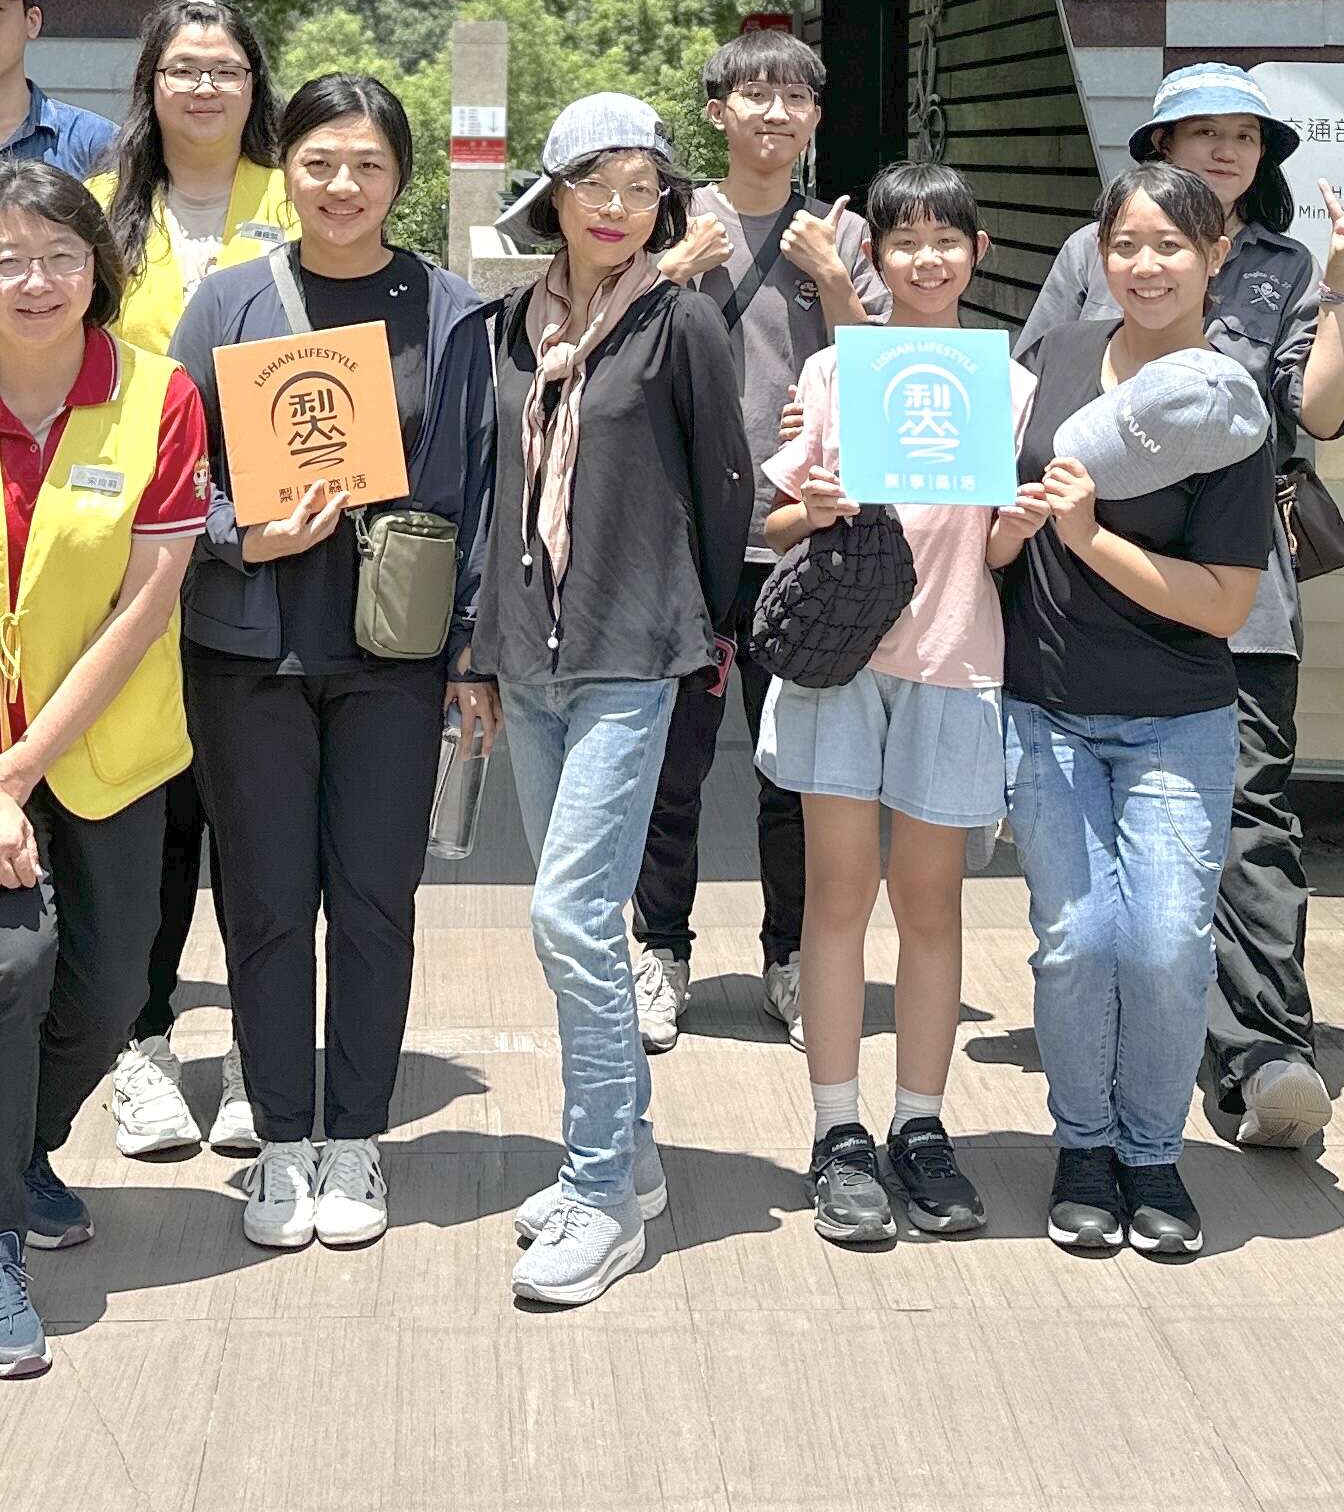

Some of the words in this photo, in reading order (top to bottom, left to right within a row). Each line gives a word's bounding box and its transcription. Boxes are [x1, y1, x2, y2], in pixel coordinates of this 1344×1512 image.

[254, 351, 295, 388] LISHAN
[297, 347, 360, 373] LIFESTYLE
[872, 343, 915, 372] LISHAN
[917, 342, 978, 375] LIFESTYLE
